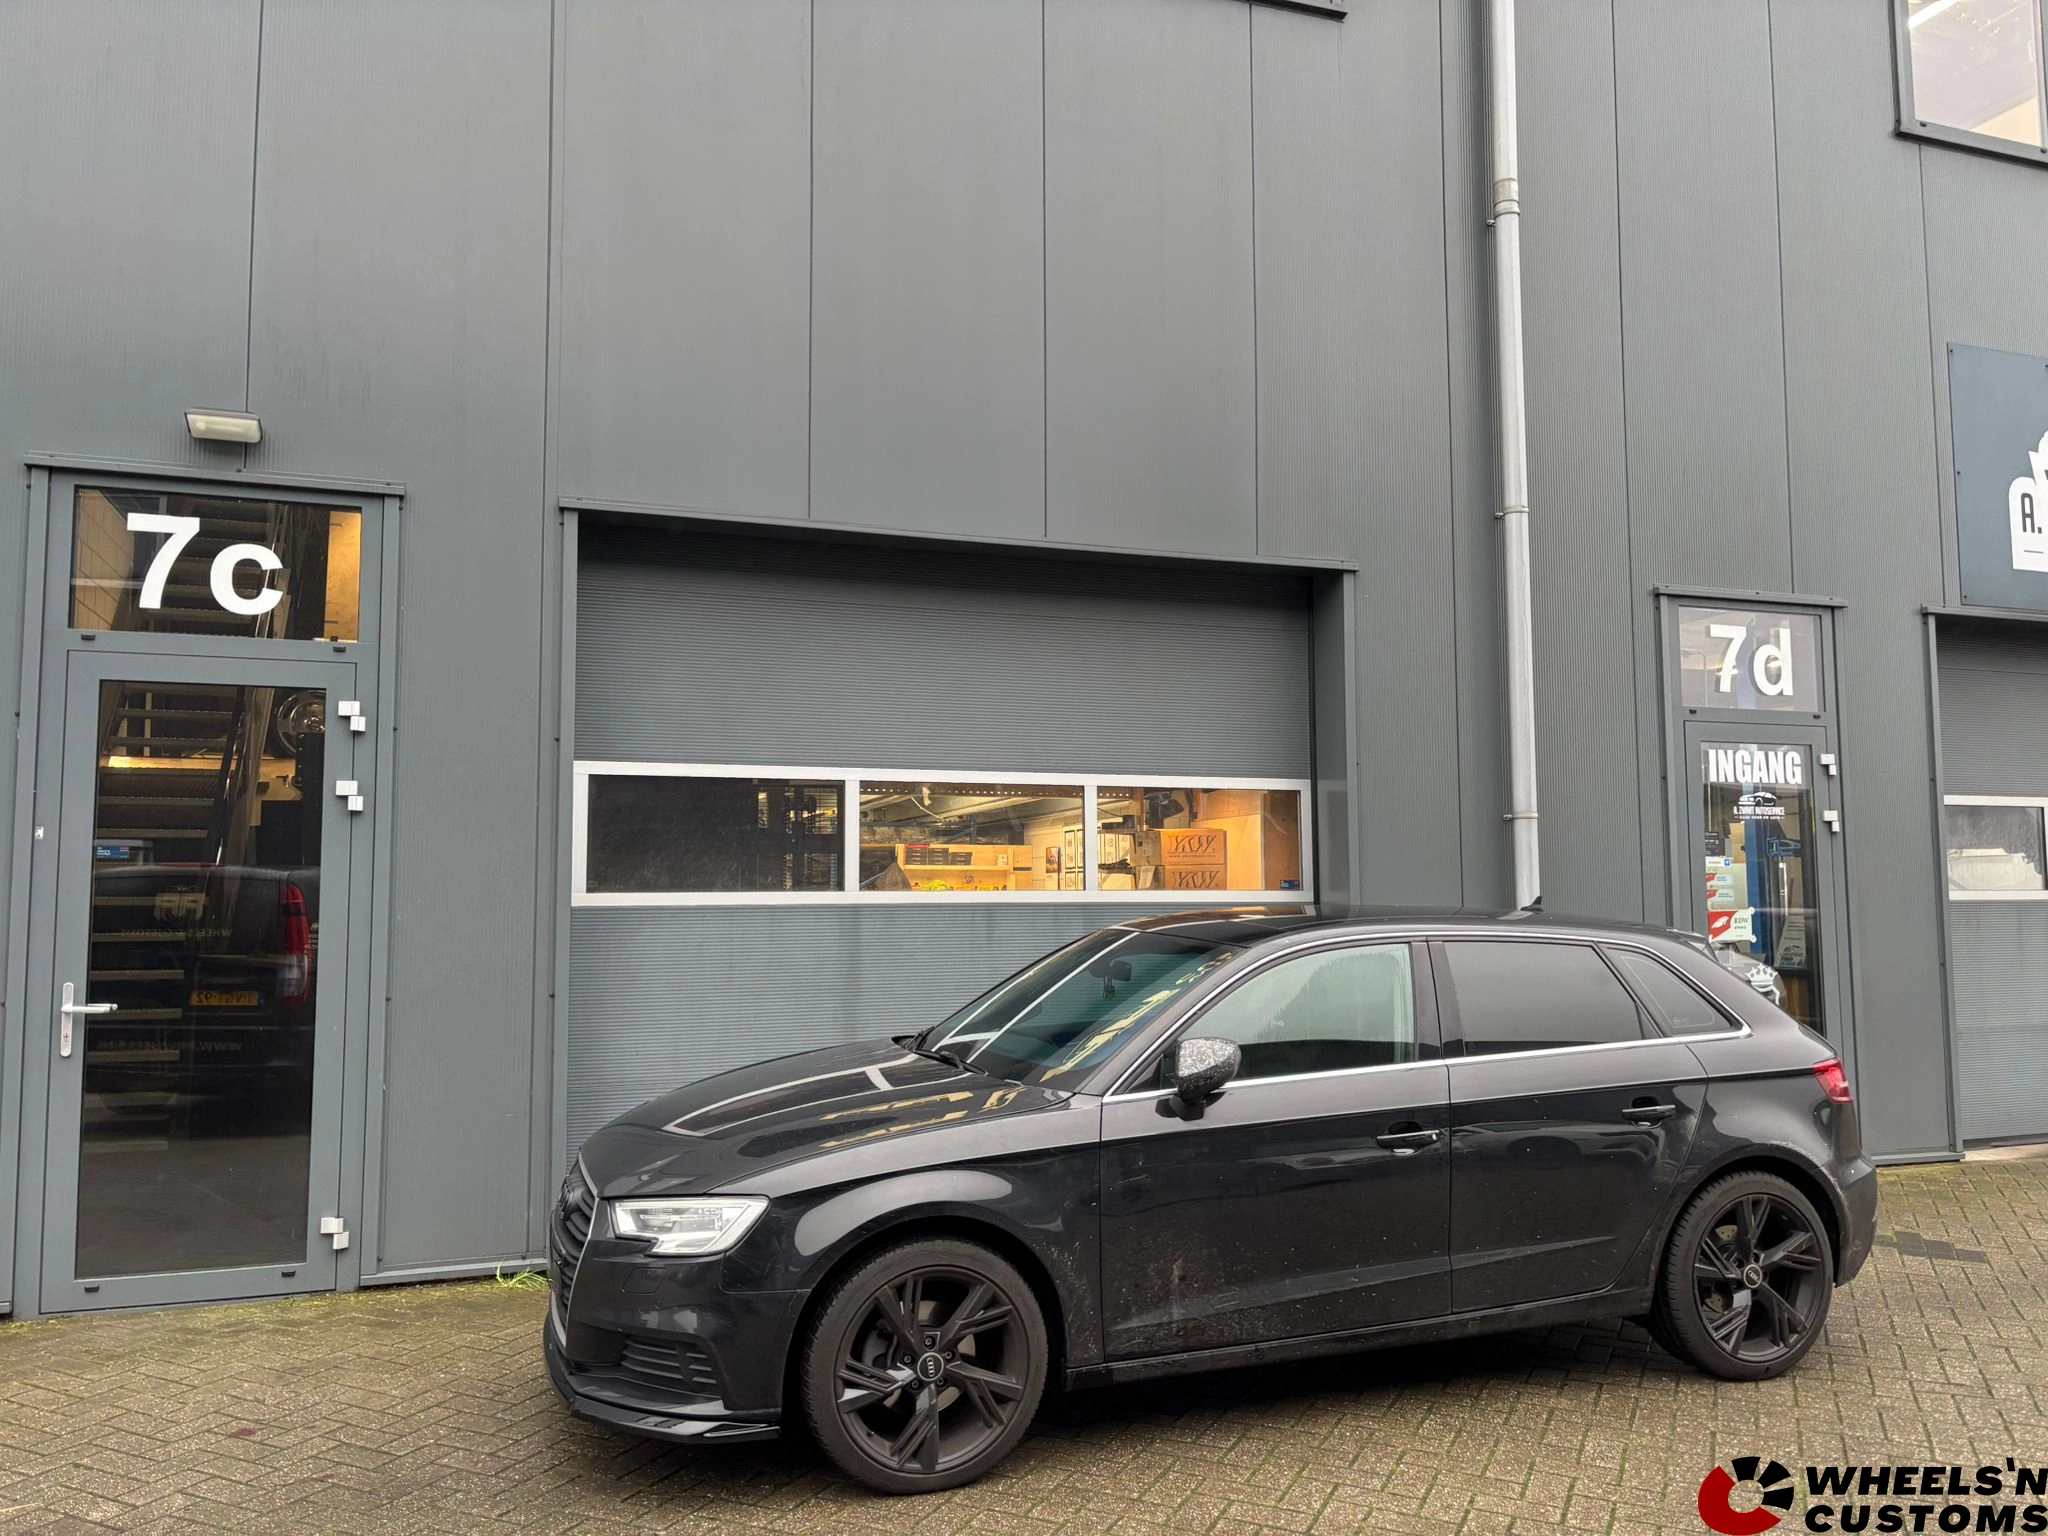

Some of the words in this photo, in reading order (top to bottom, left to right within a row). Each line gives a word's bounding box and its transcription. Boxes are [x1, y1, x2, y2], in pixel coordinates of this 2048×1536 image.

[2021, 492, 2043, 534] A.
[126, 512, 283, 615] 7c
[1707, 623, 1794, 696] 7d
[1708, 748, 1803, 785] INGANG
